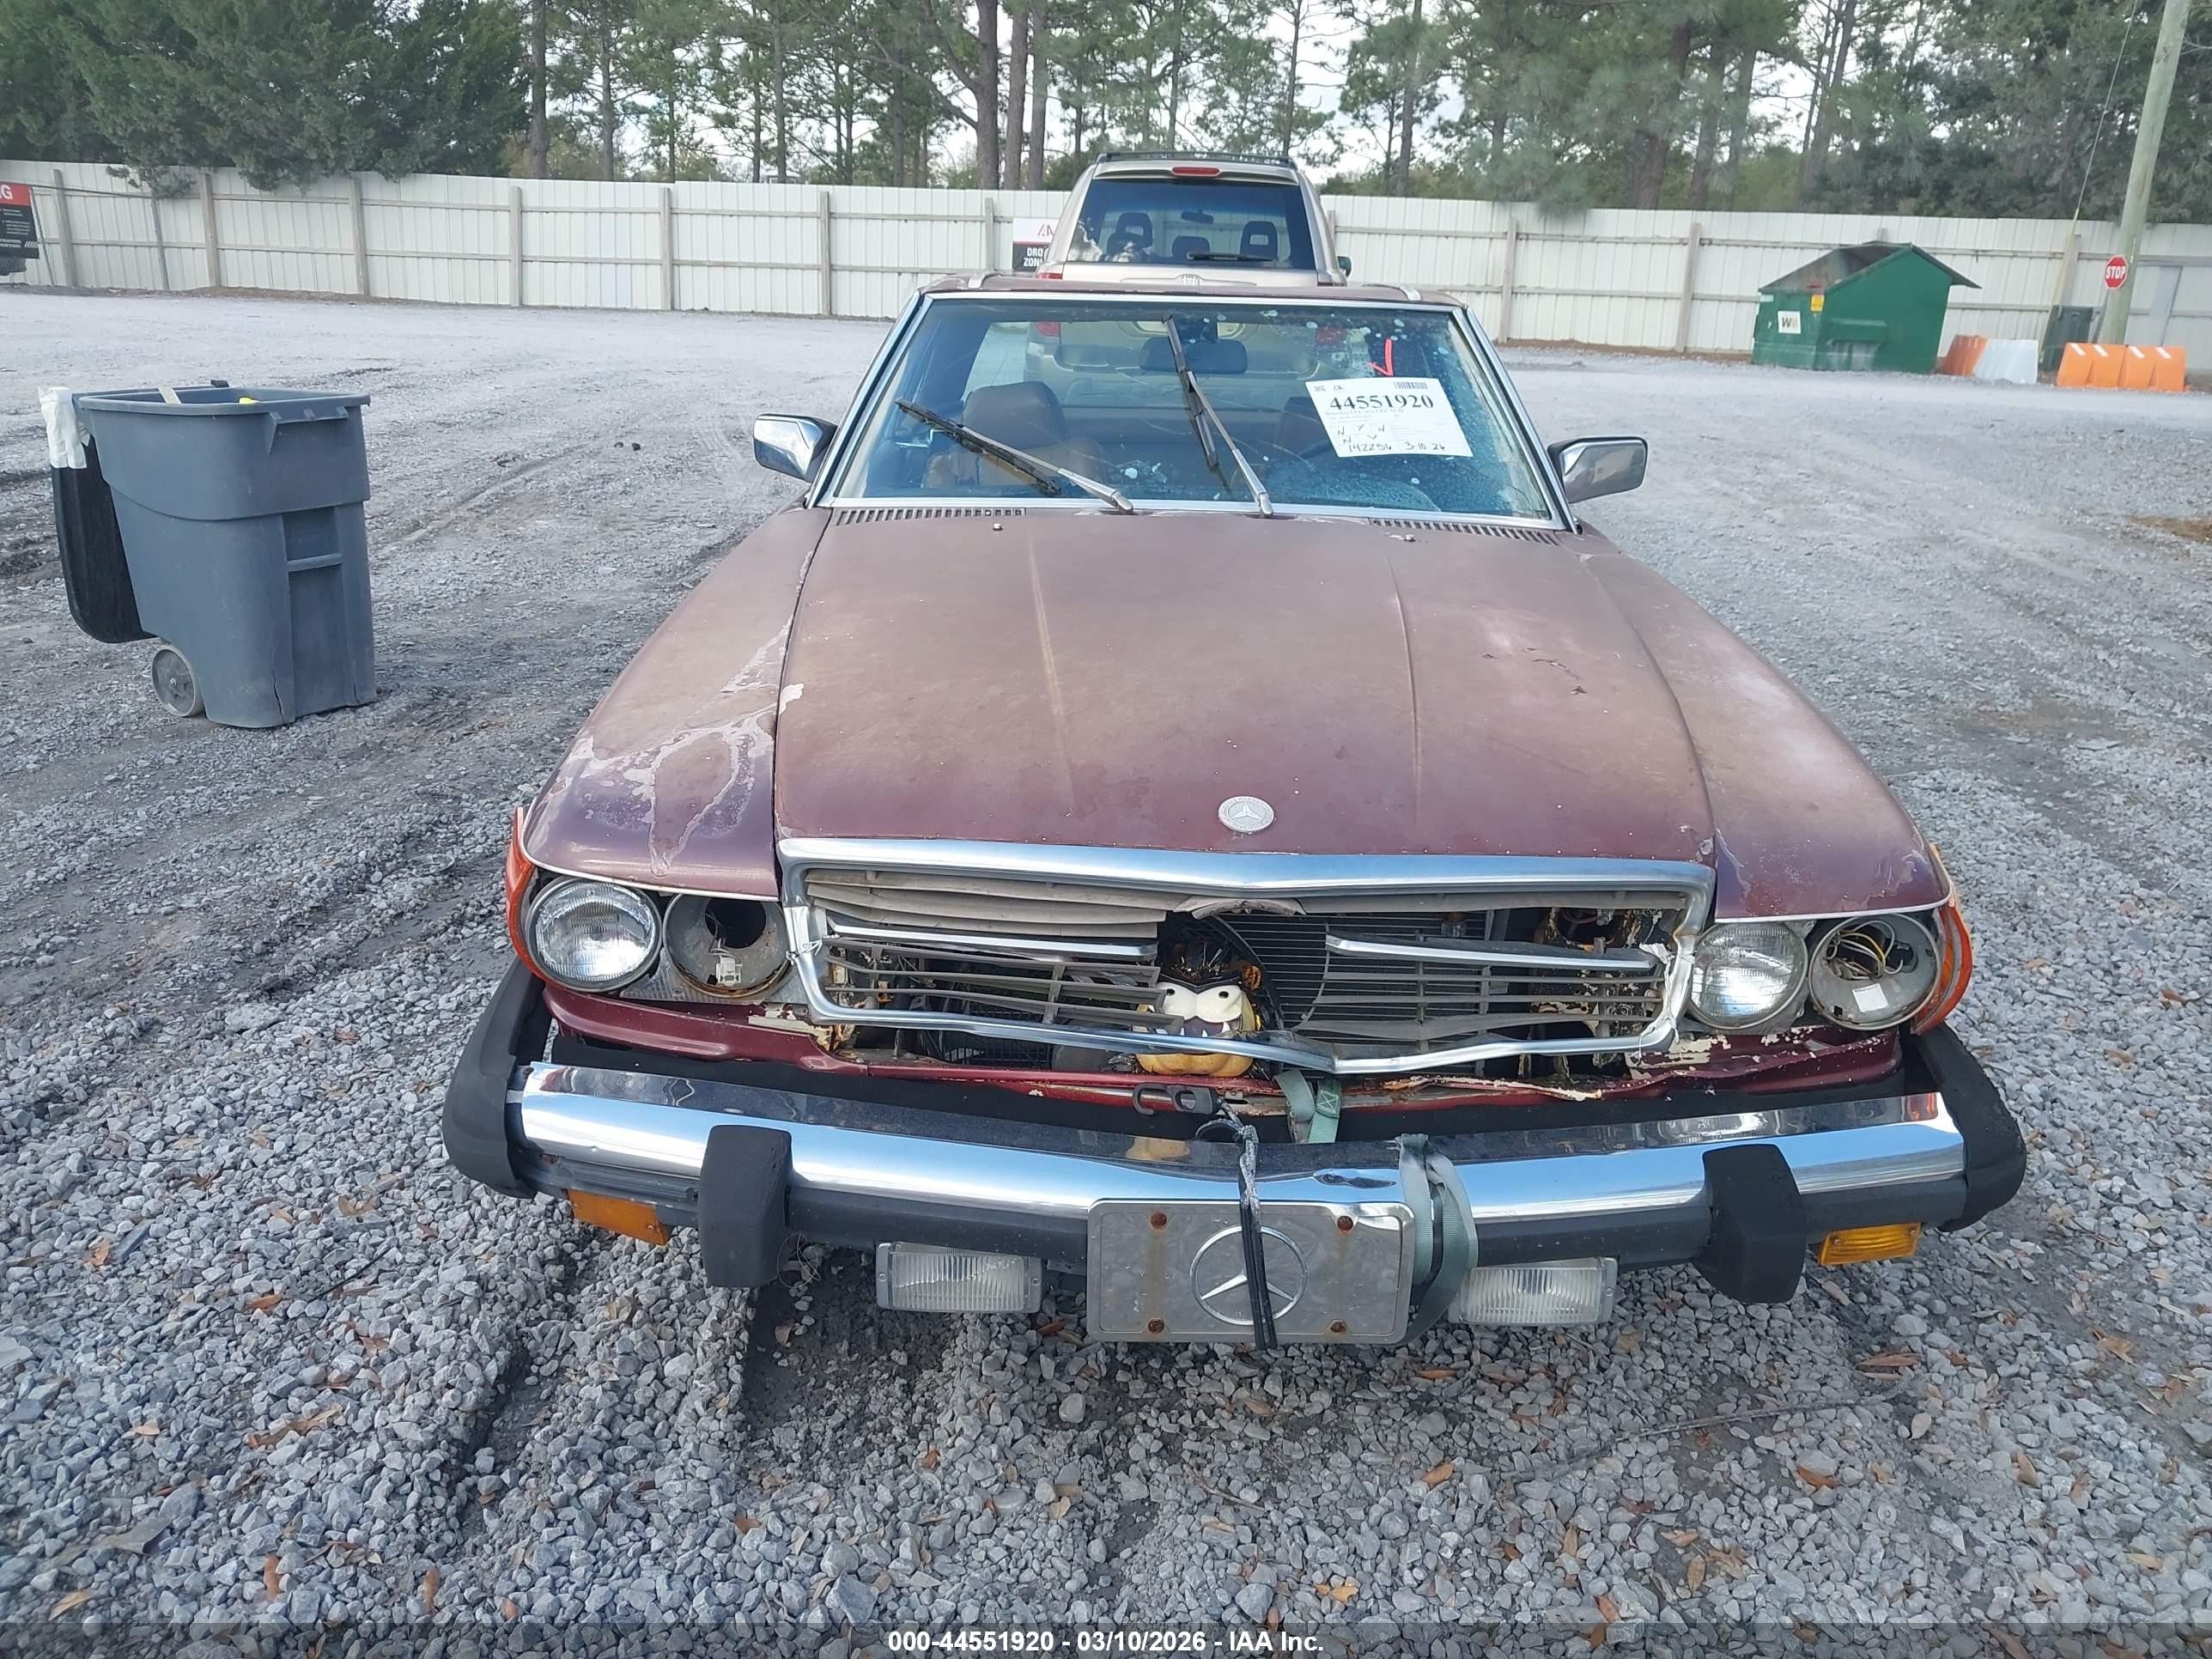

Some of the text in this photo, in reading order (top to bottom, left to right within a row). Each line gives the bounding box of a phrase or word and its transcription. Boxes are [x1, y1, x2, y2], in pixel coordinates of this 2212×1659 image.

[0, 184, 13, 199] G
[2106, 265, 2126, 279] STOP
[1330, 394, 1434, 410] 44551920
